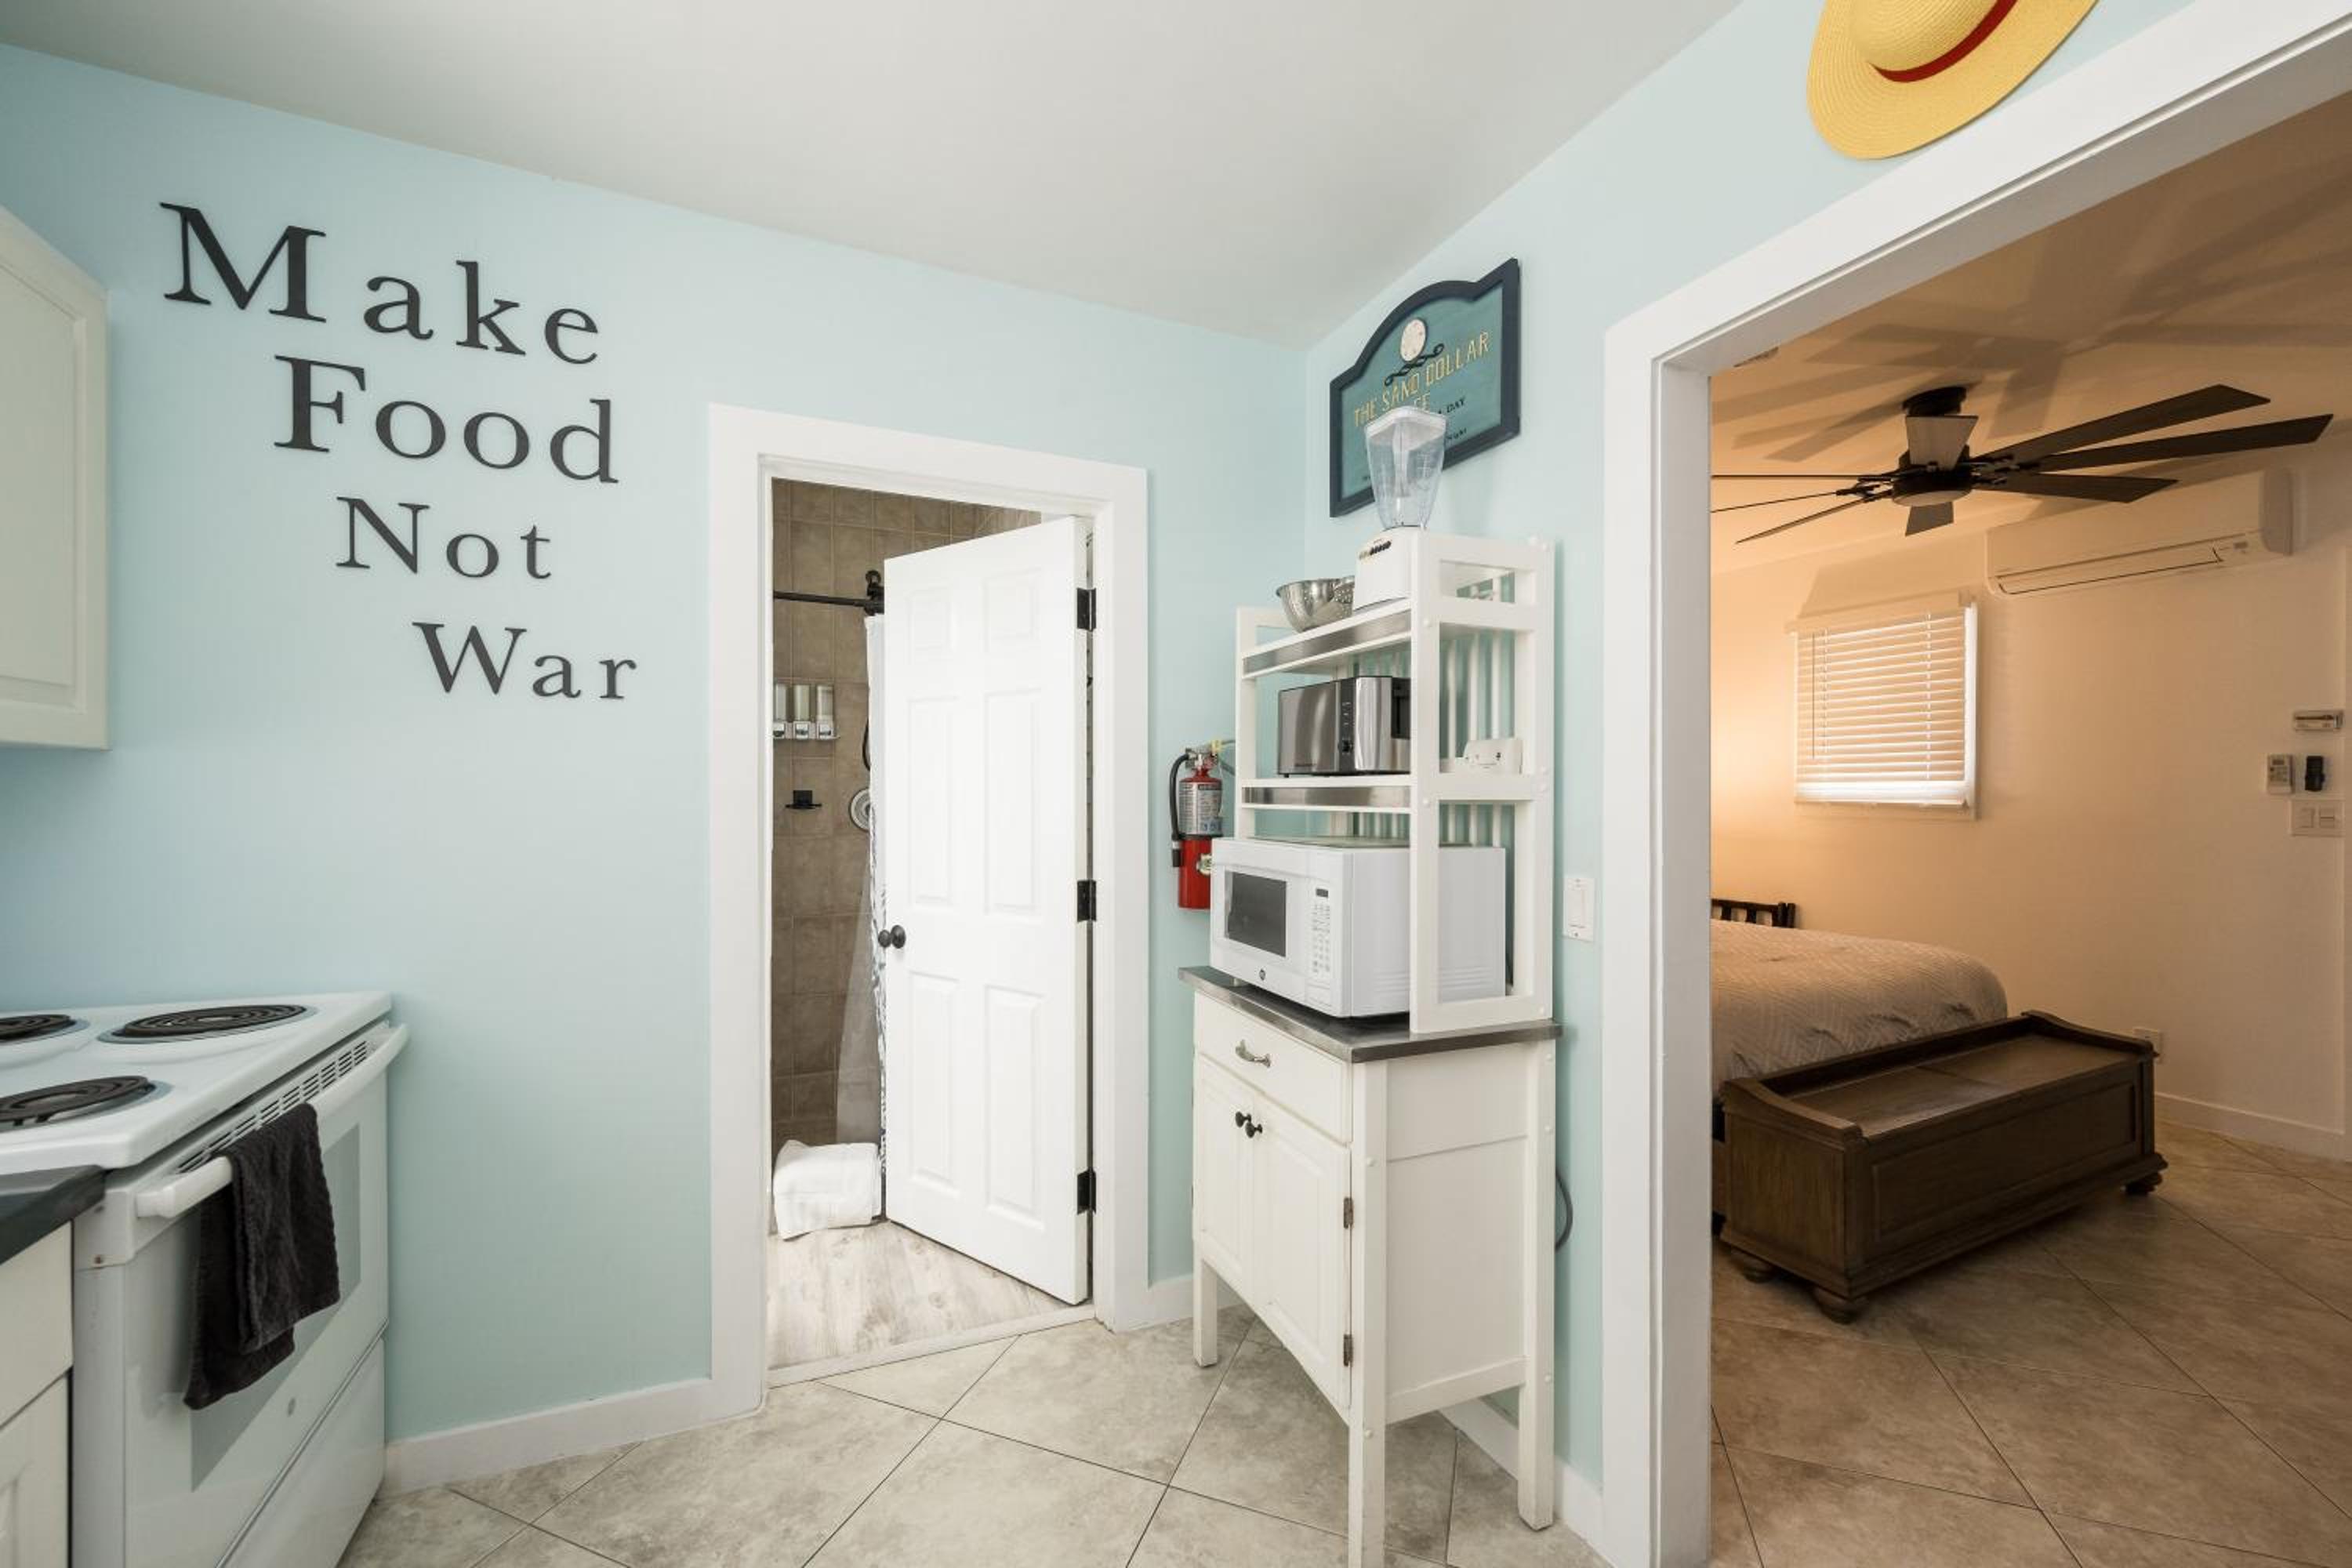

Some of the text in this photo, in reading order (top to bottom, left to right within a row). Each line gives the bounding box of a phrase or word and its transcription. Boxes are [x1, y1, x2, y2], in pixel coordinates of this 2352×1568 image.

[158, 201, 599, 365] Make
[1381, 372, 1421, 412] SAND
[1425, 332, 1488, 387] DOLLAR
[274, 355, 619, 485] Food
[336, 496, 552, 579] Not
[412, 622, 637, 699] War
